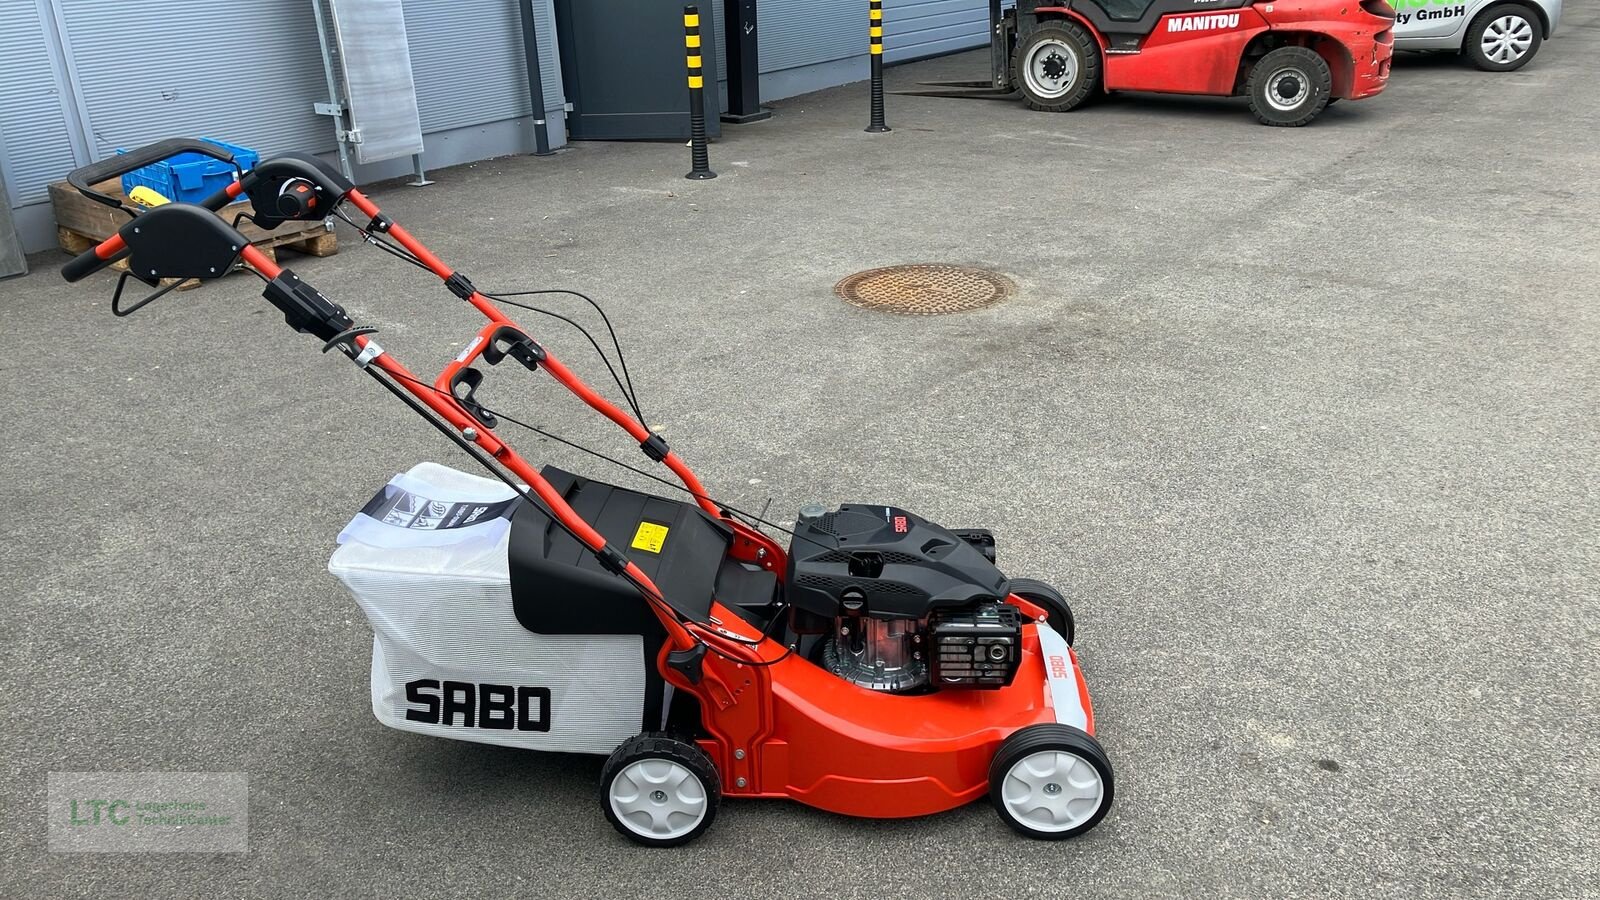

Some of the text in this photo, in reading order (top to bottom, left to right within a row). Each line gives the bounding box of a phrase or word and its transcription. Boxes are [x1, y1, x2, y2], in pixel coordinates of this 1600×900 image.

[1167, 13, 1240, 32] MANITOU
[1396, 5, 1465, 25] ty GmbH
[895, 516, 908, 533] SABO
[1049, 655, 1067, 679] SABO
[405, 678, 551, 732] SABO
